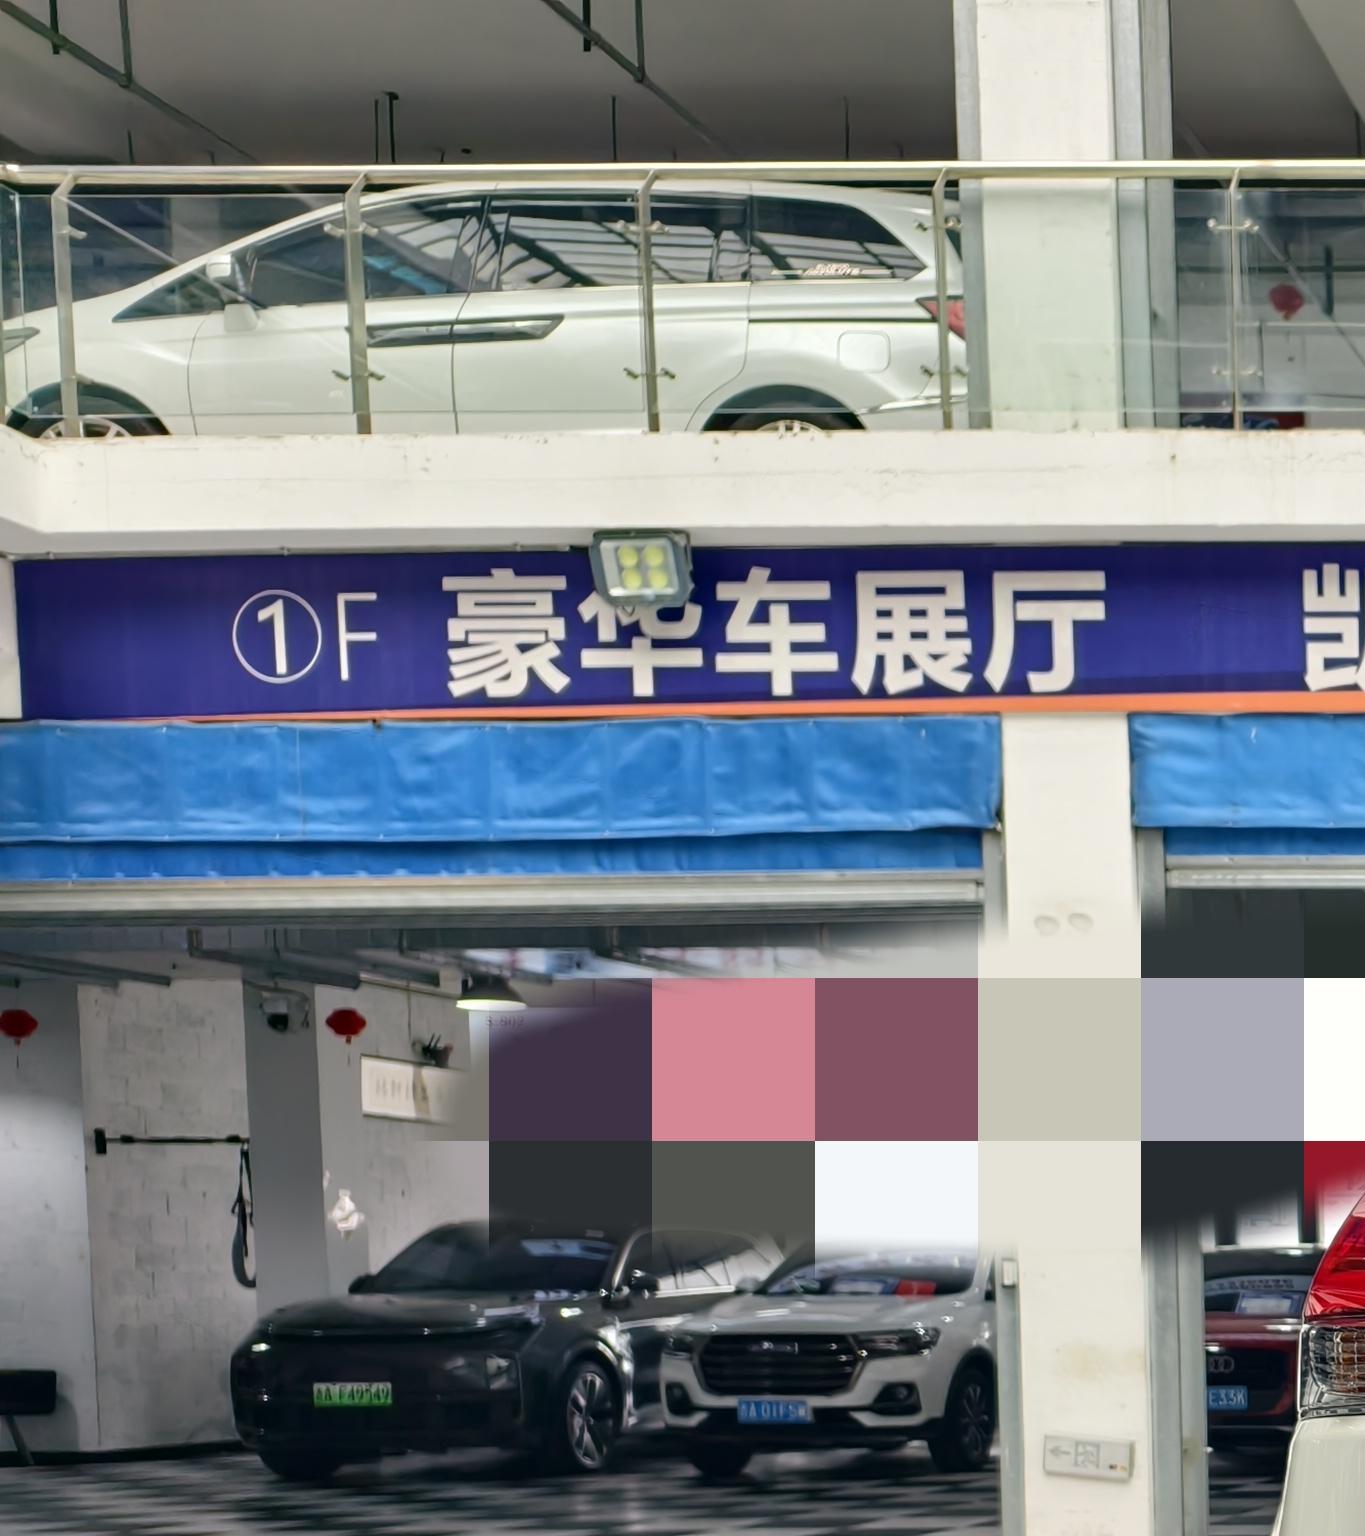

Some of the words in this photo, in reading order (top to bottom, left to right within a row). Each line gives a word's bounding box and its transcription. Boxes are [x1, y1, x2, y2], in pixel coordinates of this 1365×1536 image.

[441, 566, 1108, 698] 豪华车展厅
